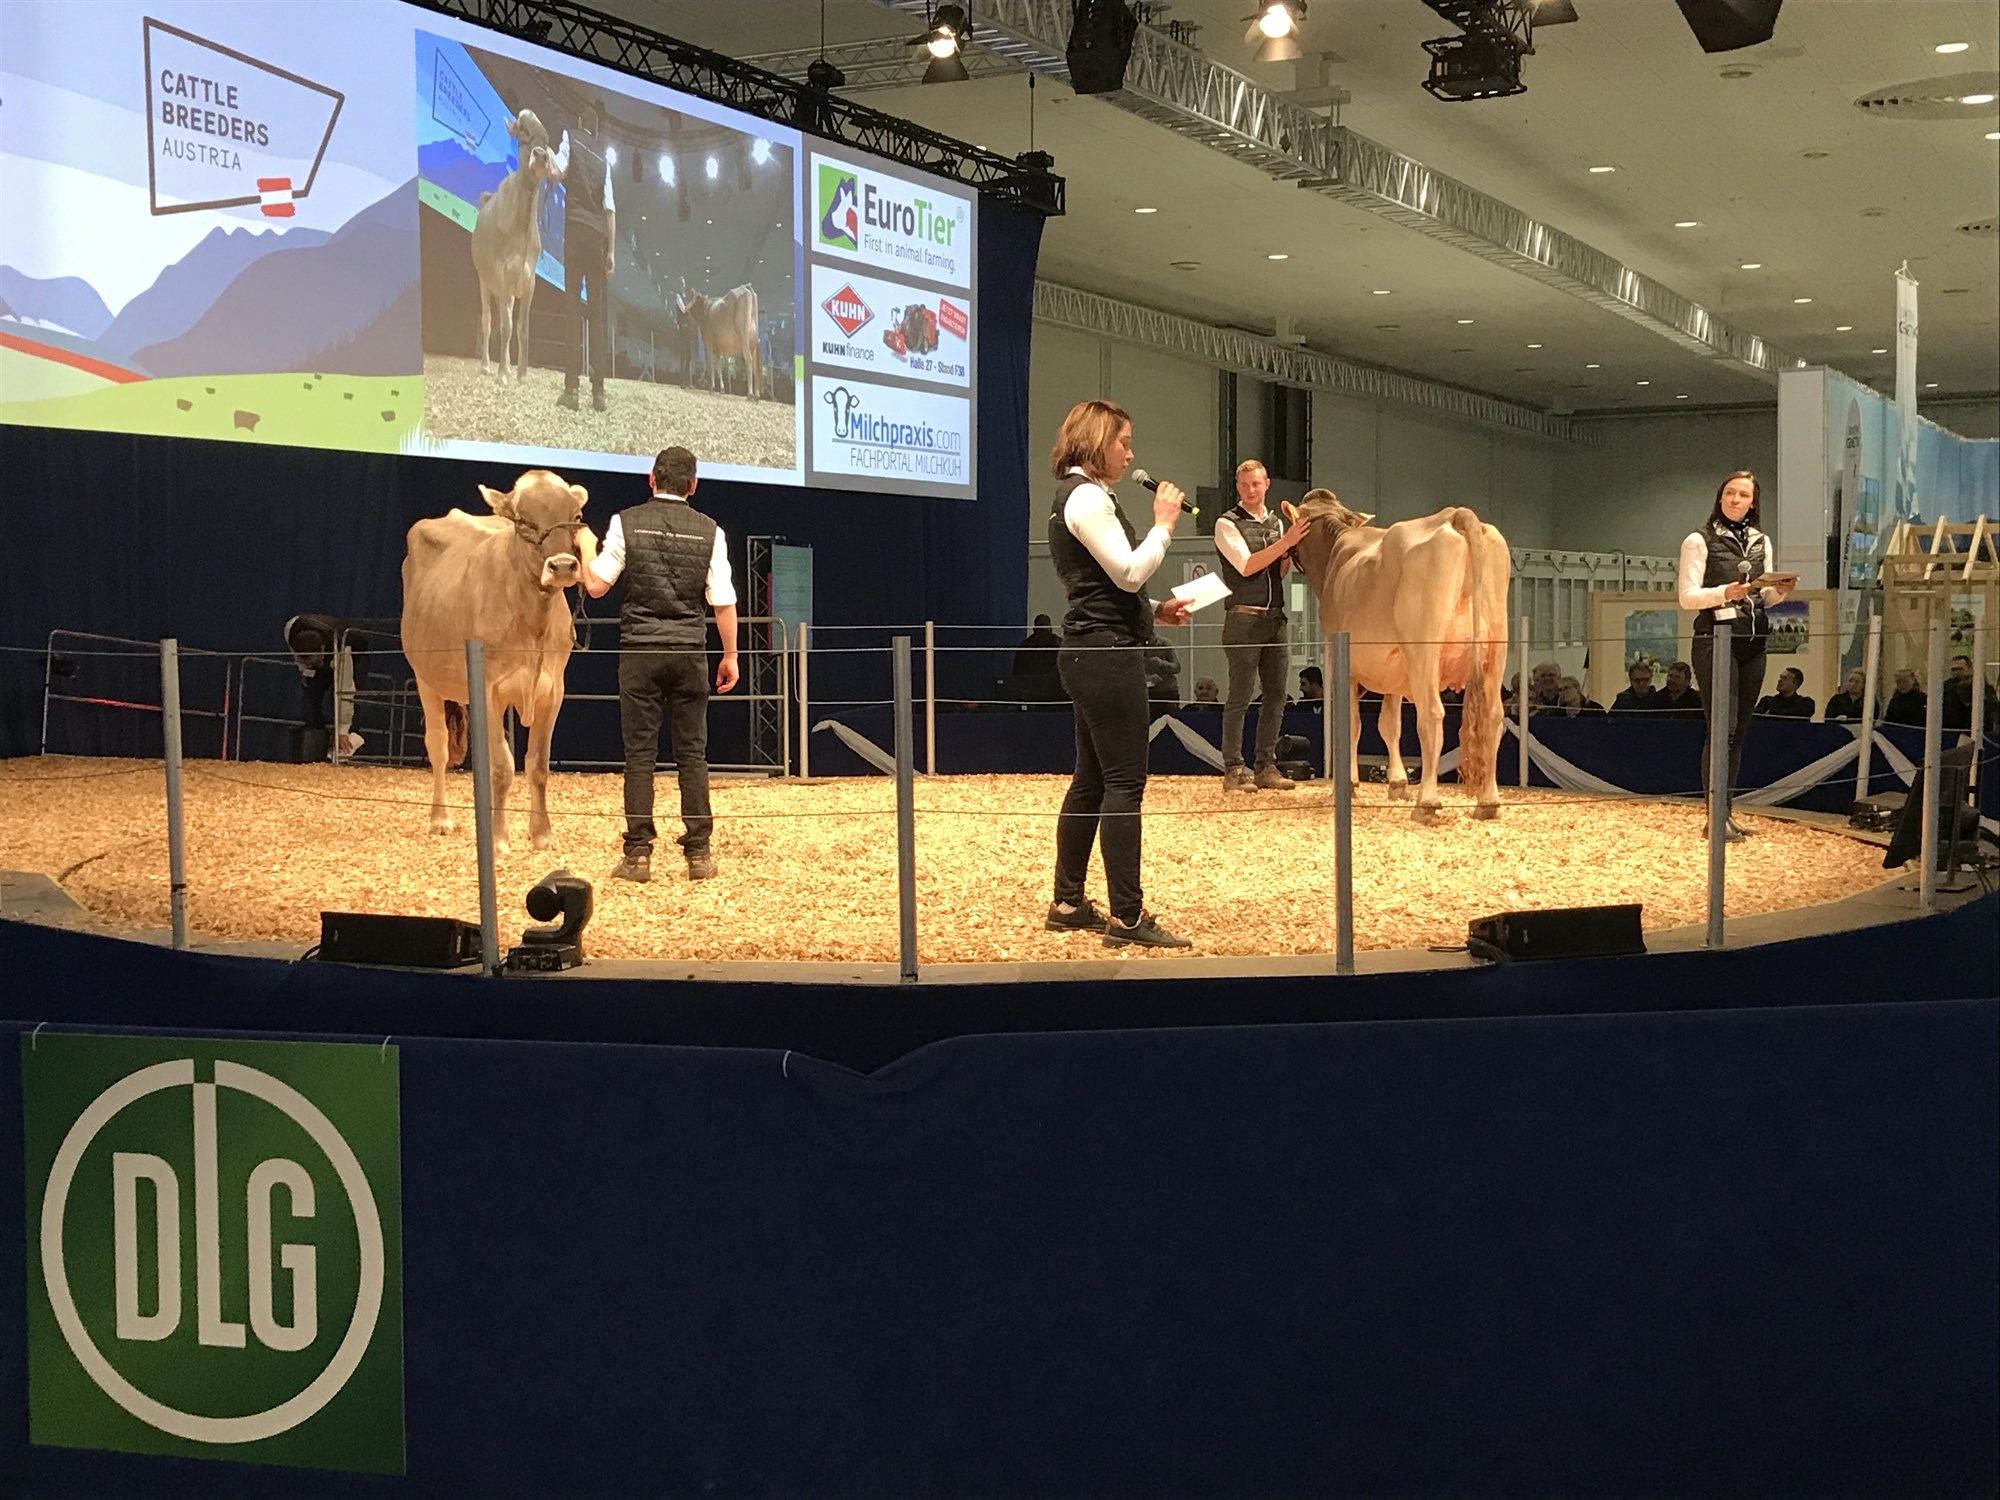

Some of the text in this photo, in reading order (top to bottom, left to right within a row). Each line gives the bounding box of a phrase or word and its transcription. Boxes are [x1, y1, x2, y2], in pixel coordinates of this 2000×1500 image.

[160, 69, 239, 110] CATTLE
[162, 101, 270, 147] BREEDERS
[162, 137, 242, 171] AUSTRIA
[864, 183, 956, 247] EuroTier
[864, 234, 882, 254] First
[885, 242, 893, 254] in
[895, 243, 923, 263] animal
[831, 299, 865, 322] KUHN
[822, 341, 875, 361] KUHNfinance
[910, 356, 925, 370] Halle
[925, 359, 933, 371] 27
[938, 361, 954, 376] Stand
[851, 412, 961, 450] Milchpraxis.com
[850, 448, 962, 477] FACHPORTAL MILCHKUH
[112, 1082, 318, 1352] DLG
